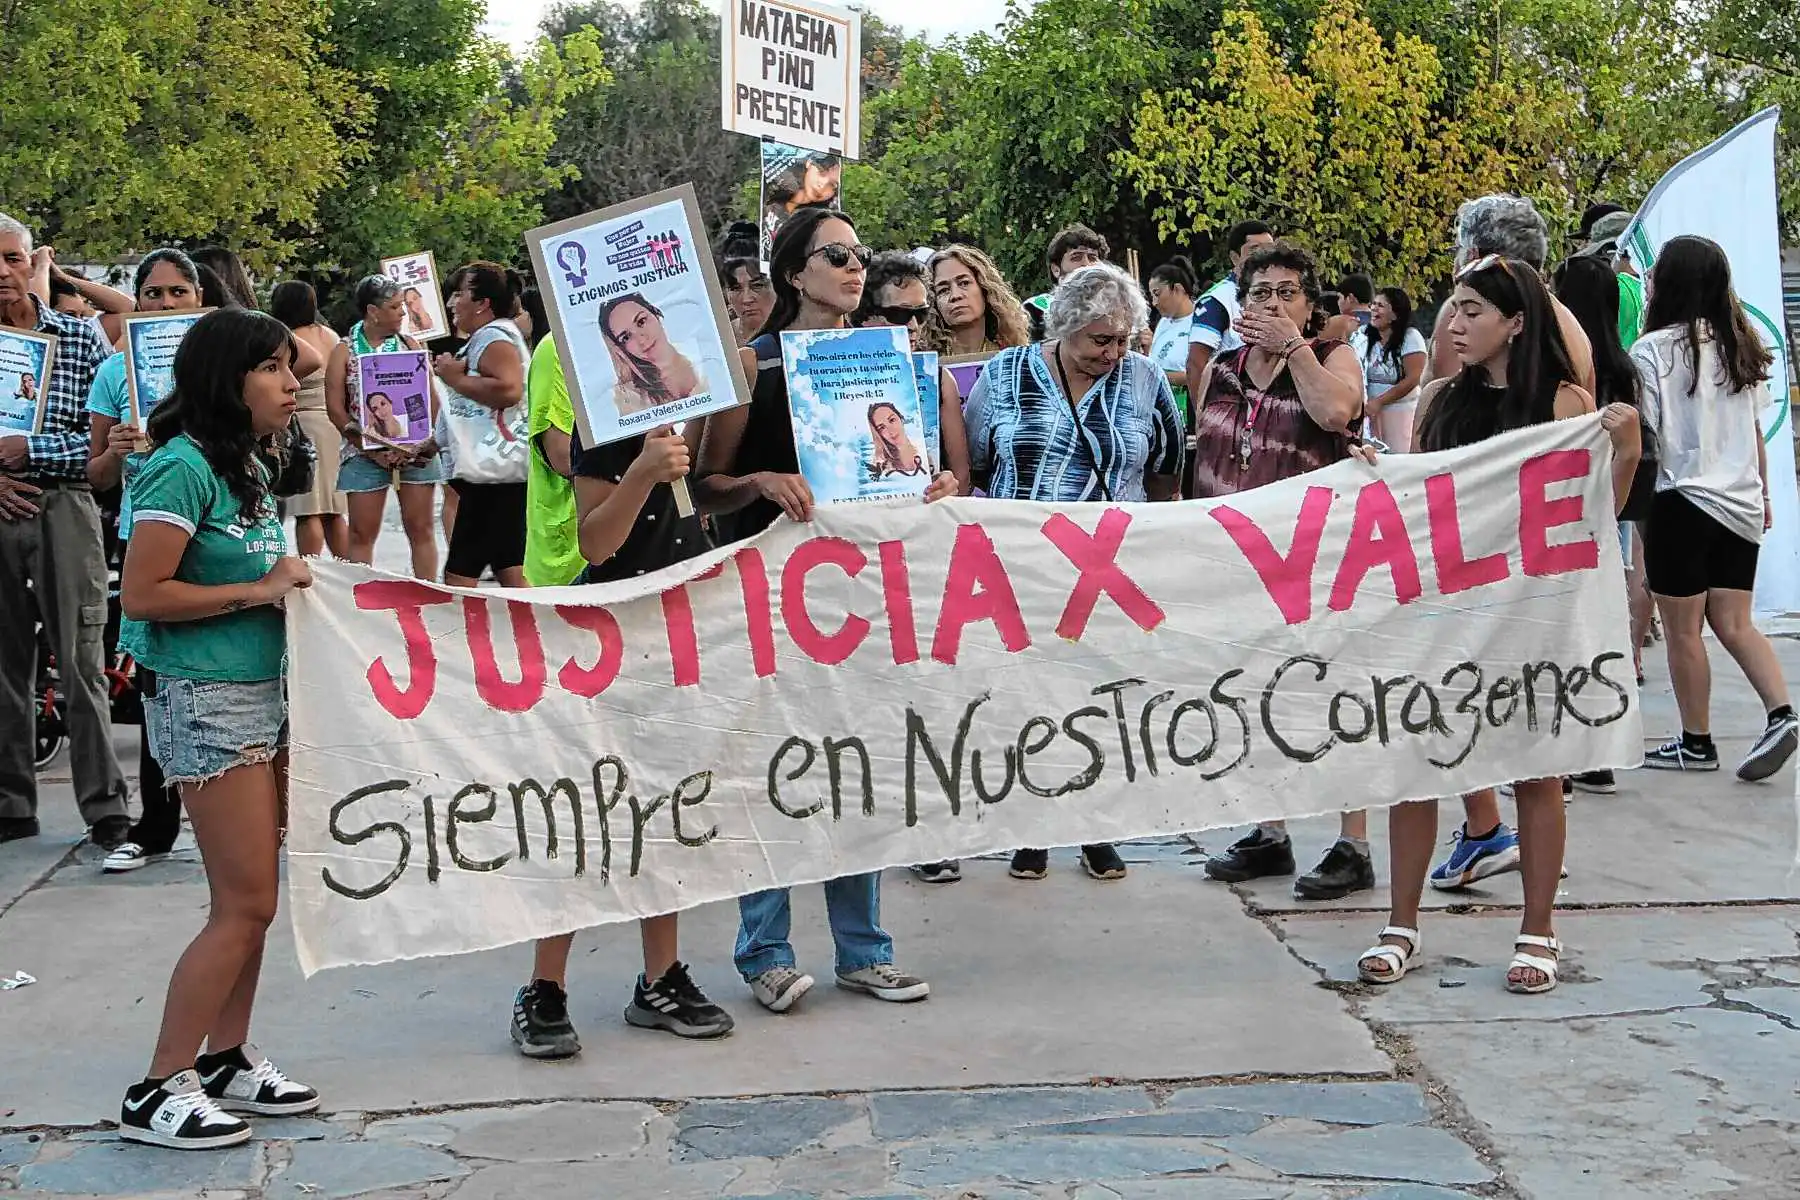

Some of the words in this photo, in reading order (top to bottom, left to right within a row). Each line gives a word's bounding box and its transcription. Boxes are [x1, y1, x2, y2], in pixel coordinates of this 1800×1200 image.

[740, 0, 837, 59] NATASHA
[736, 83, 840, 138] PRESENTE
[568, 279, 628, 306] EXIGIMOS
[632, 261, 689, 288] JUSTICIA
[618, 411, 651, 427] Roxana
[652, 402, 684, 417] Valeria
[684, 394, 712, 409] Lobos
[1208, 448, 1599, 625] VALE
[767, 735, 876, 822] en
